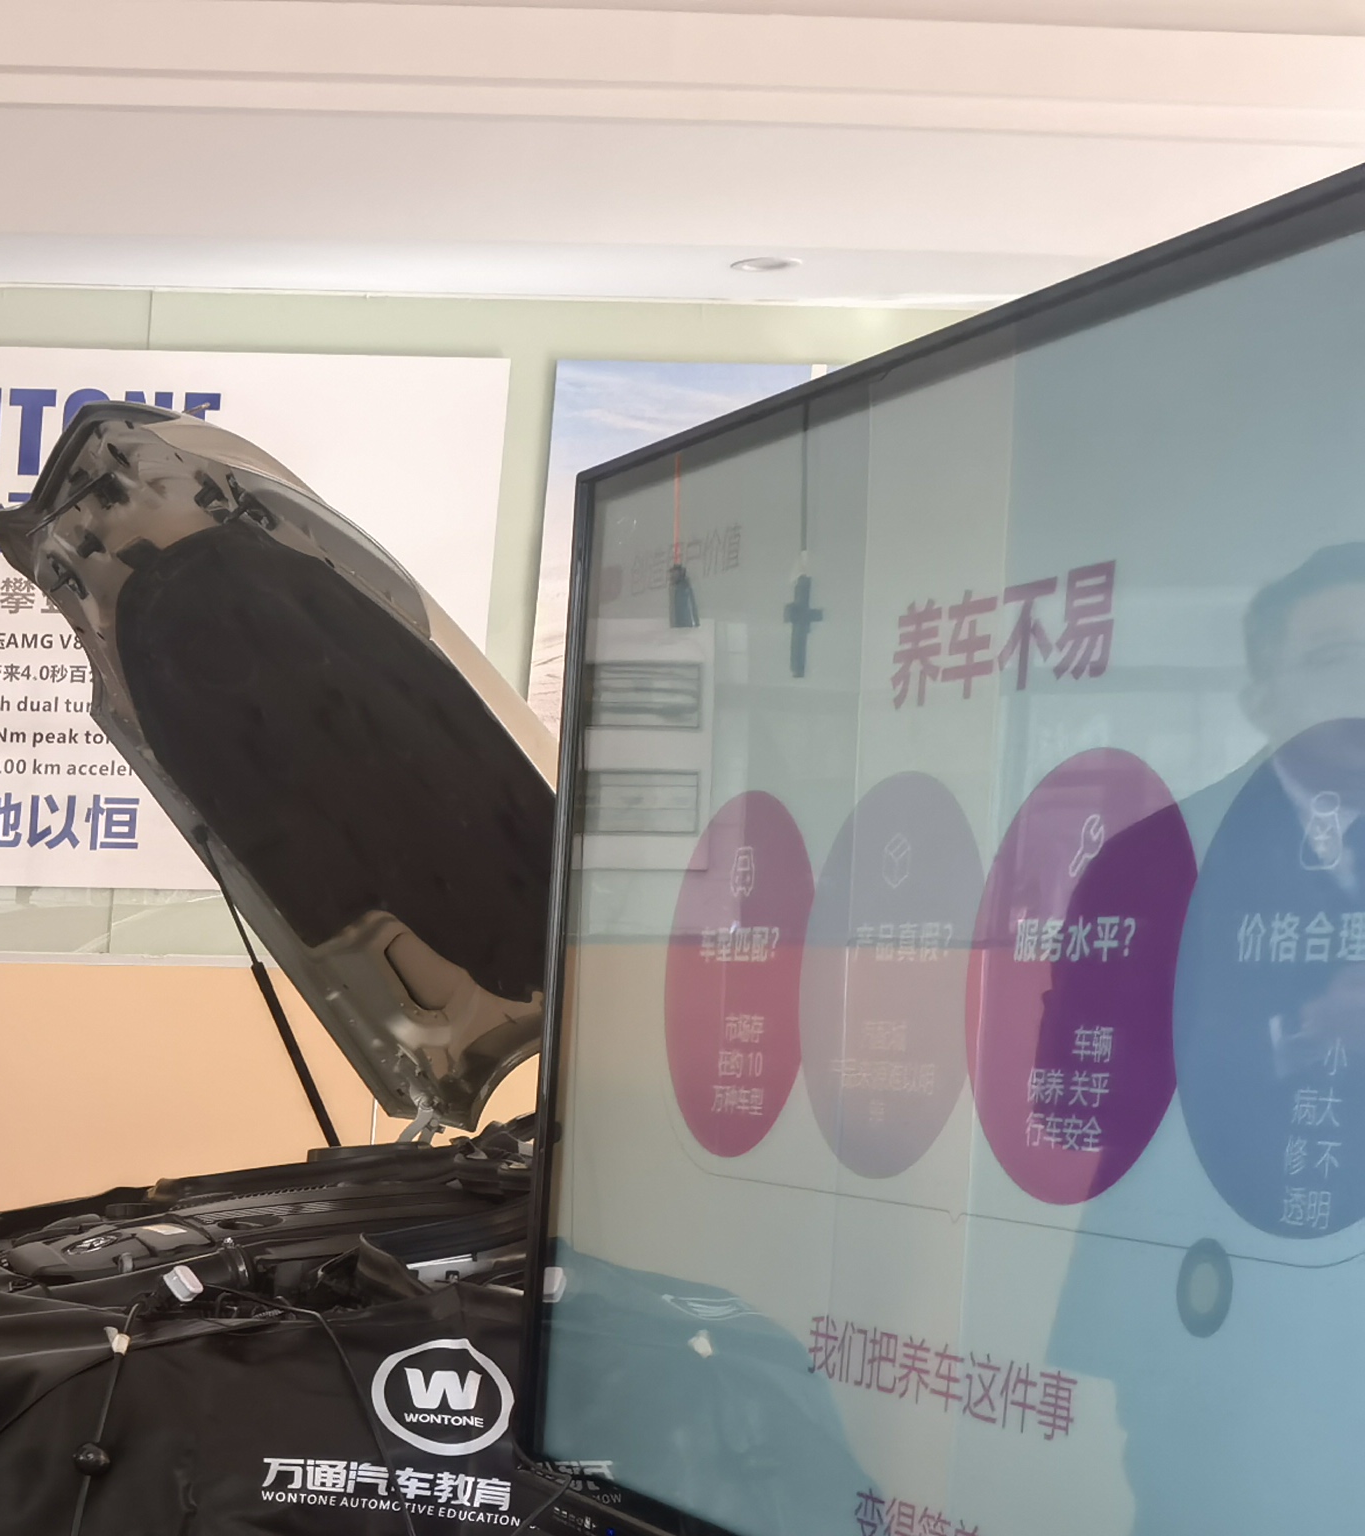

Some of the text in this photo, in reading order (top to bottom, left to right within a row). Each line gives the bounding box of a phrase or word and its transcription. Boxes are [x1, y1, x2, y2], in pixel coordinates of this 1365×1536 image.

[891, 560, 1116, 710] 养车不易
[17, 696, 58, 713] dual
[32, 729, 78, 748] peak
[32, 759, 60, 776] km
[1014, 916, 1137, 963] 服务水平?
[1072, 1025, 1114, 1062] 车辆
[1324, 1038, 1347, 1076] 小
[1028, 1068, 1063, 1105] 保养
[1291, 1086, 1341, 1127] 病大
[1025, 1112, 1103, 1152] 行车安全
[1279, 1187, 1331, 1230] 透明
[404, 1367, 482, 1410] W
[808, 1315, 1077, 1440] 我们把养车这件事
[404, 1412, 484, 1429] WONTONE
[262, 1458, 512, 1511] 万通汽车教育
[261, 1490, 336, 1507] WONTONE
[438, 1507, 521, 1527] EDUCATION
